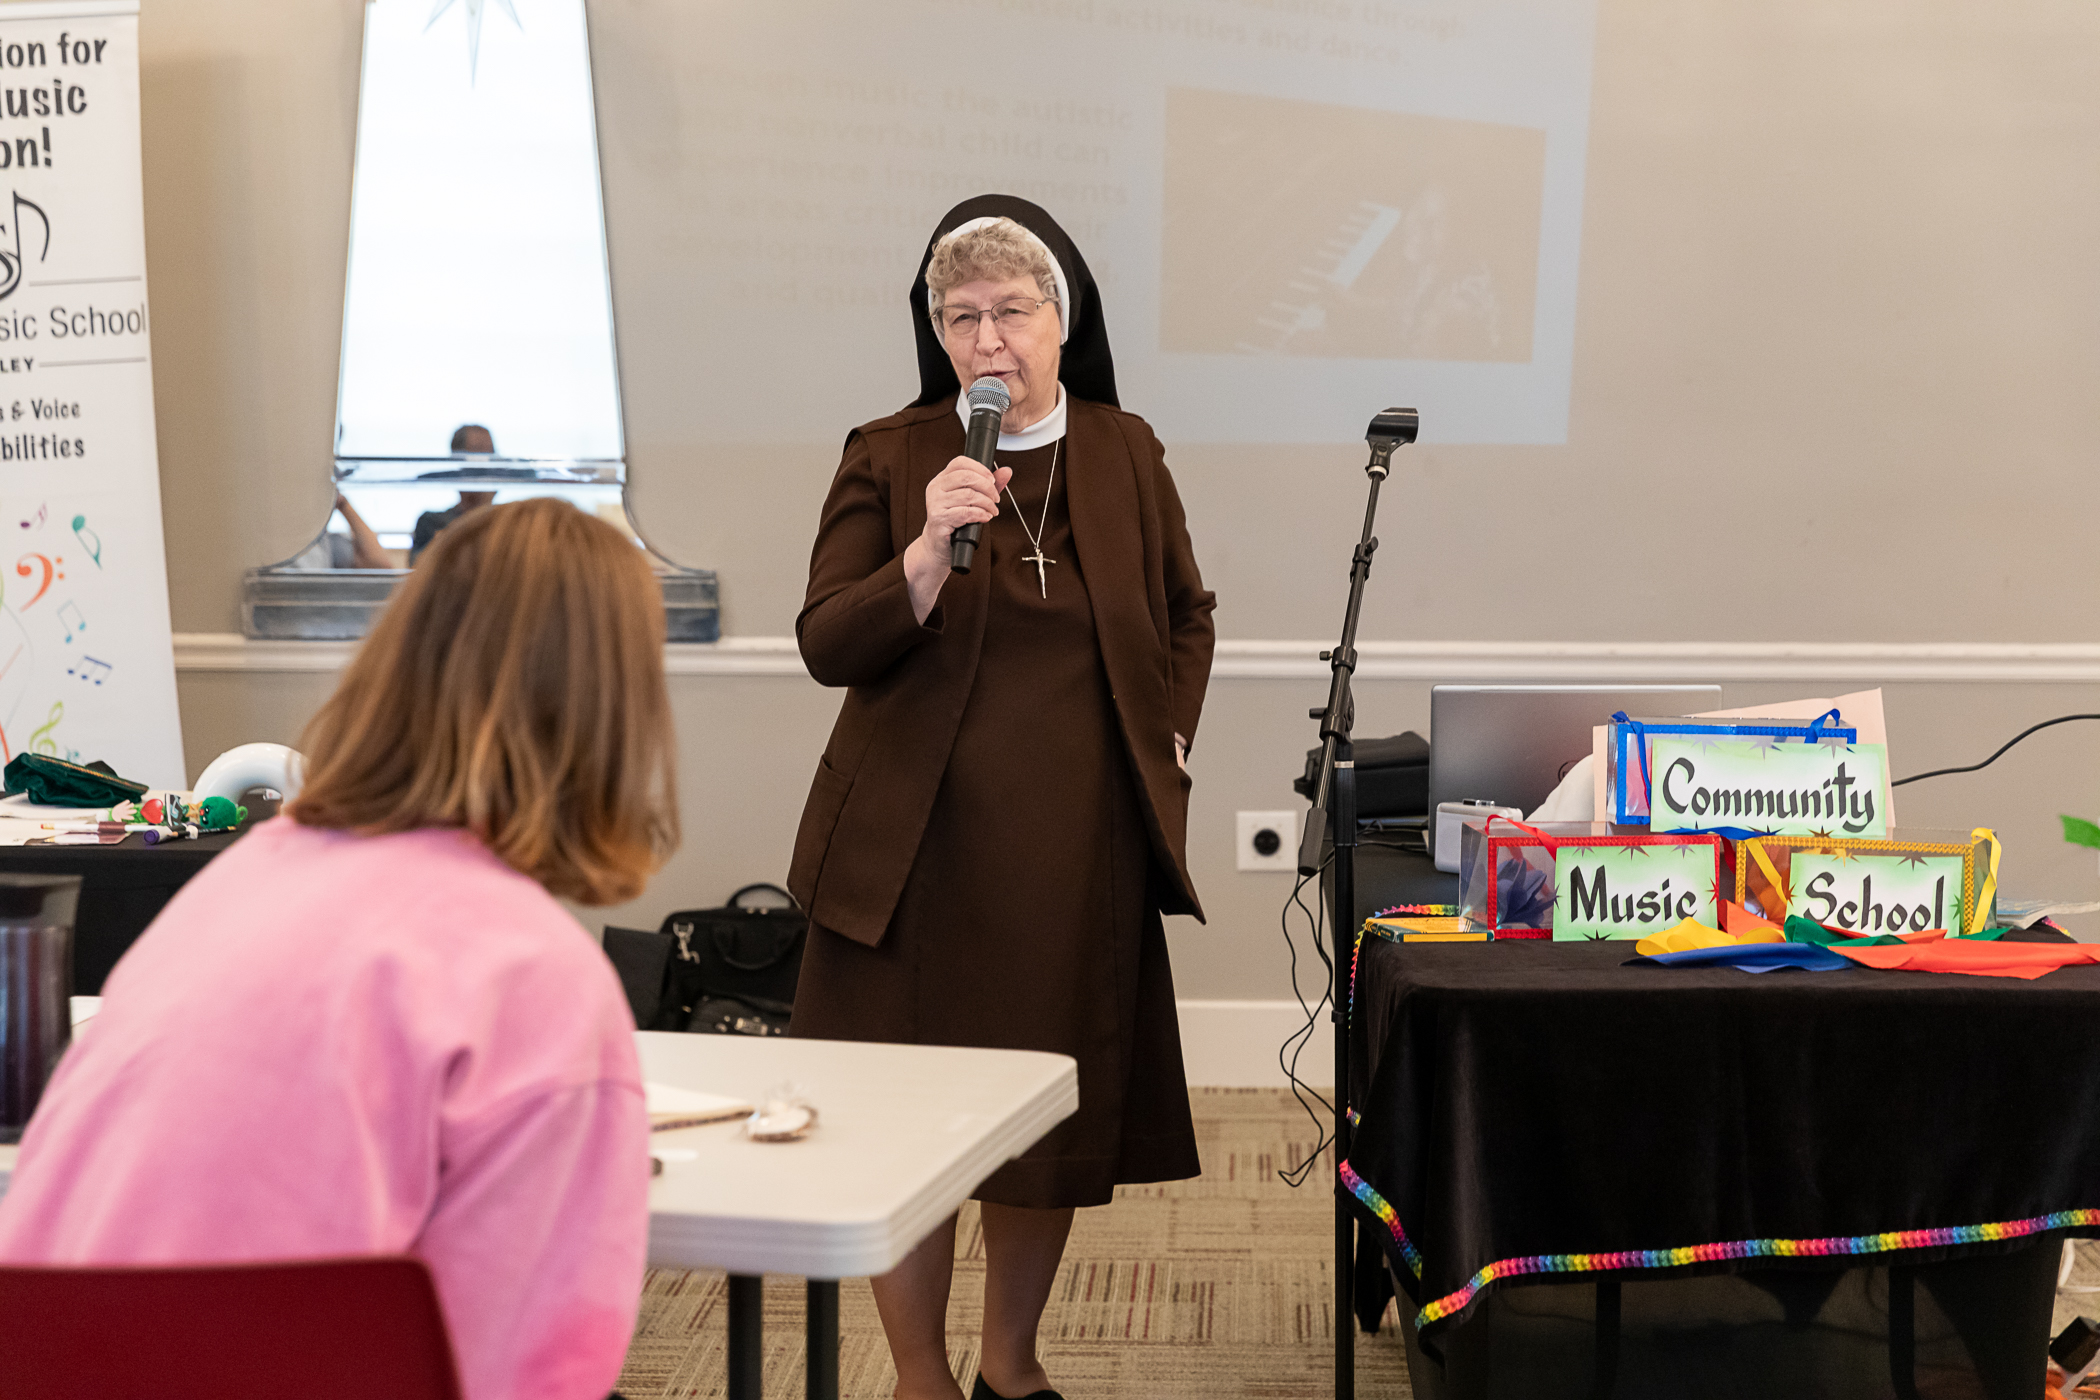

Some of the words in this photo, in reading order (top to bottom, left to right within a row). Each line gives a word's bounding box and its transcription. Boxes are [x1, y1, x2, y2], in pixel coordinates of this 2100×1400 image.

[1103, 5, 1248, 46] activities
[1257, 27, 1311, 54] and
[1361, 2, 1465, 44] through
[57, 32, 107, 65] for
[0, 79, 87, 120] usic
[822, 69, 930, 110] music
[942, 85, 999, 117] the
[1012, 98, 1133, 131] autistic
[0, 127, 52, 169] on!
[758, 113, 946, 151] nonverbal
[958, 128, 1043, 159] child
[1055, 142, 1111, 167] can
[884, 161, 1129, 206] improvements
[0, 308, 37, 341] sic
[50, 301, 146, 339] School
[0, 357, 33, 373] LEY
[31, 398, 80, 420] Voice
[1, 433, 84, 460] bilities
[1662, 757, 1875, 833] Community
[1570, 864, 1698, 923] Music
[1803, 871, 1945, 932] School
